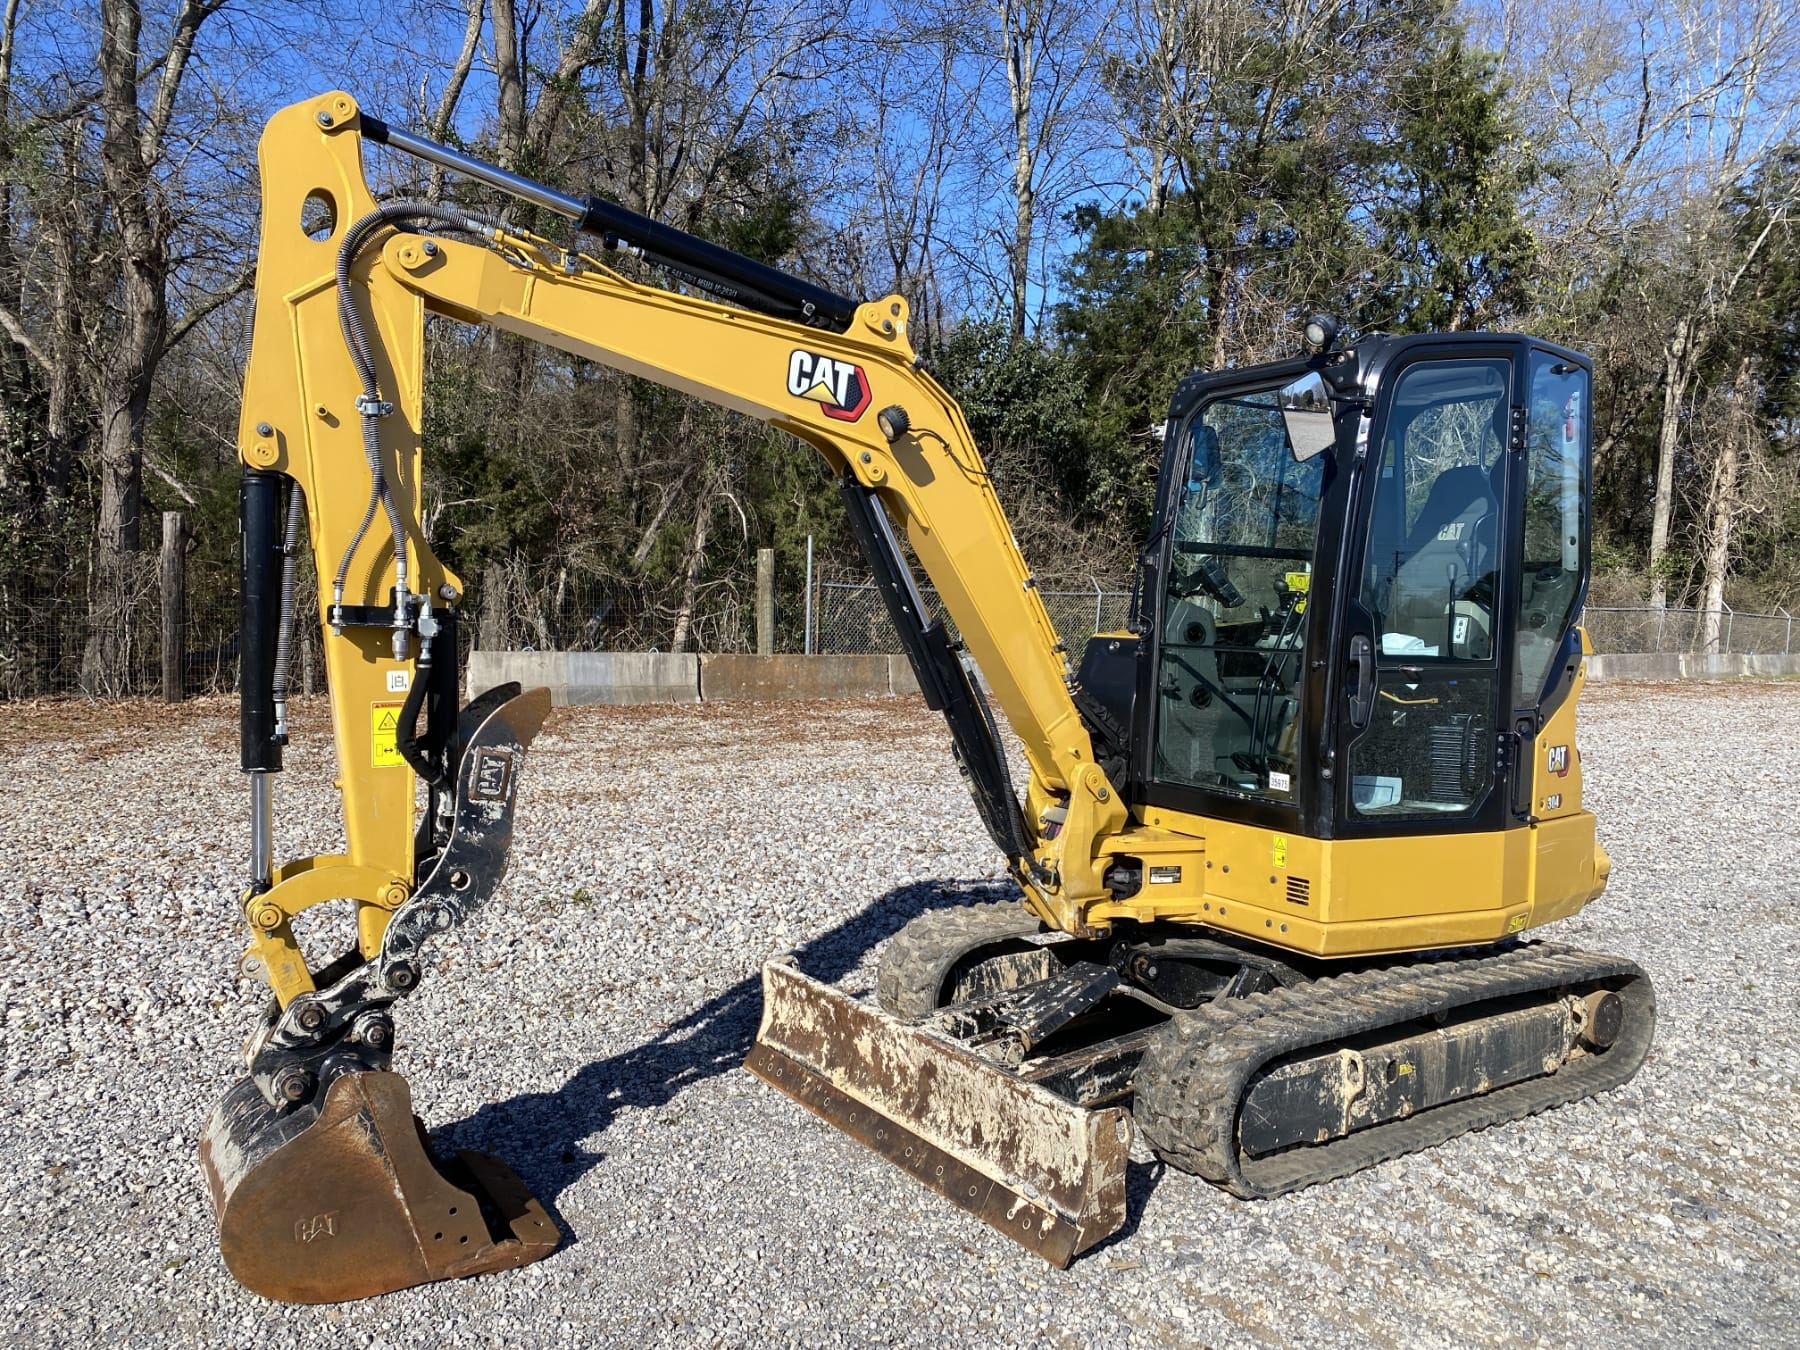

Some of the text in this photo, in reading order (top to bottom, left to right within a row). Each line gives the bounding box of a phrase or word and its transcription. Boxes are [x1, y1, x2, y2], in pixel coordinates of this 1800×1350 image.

[788, 350, 855, 407] CAT
[1437, 523, 1464, 540] CAT
[1548, 746, 1567, 772] CAT
[478, 757, 505, 795] CAT
[1547, 794, 1560, 810] 304
[294, 1211, 339, 1244] CAT
